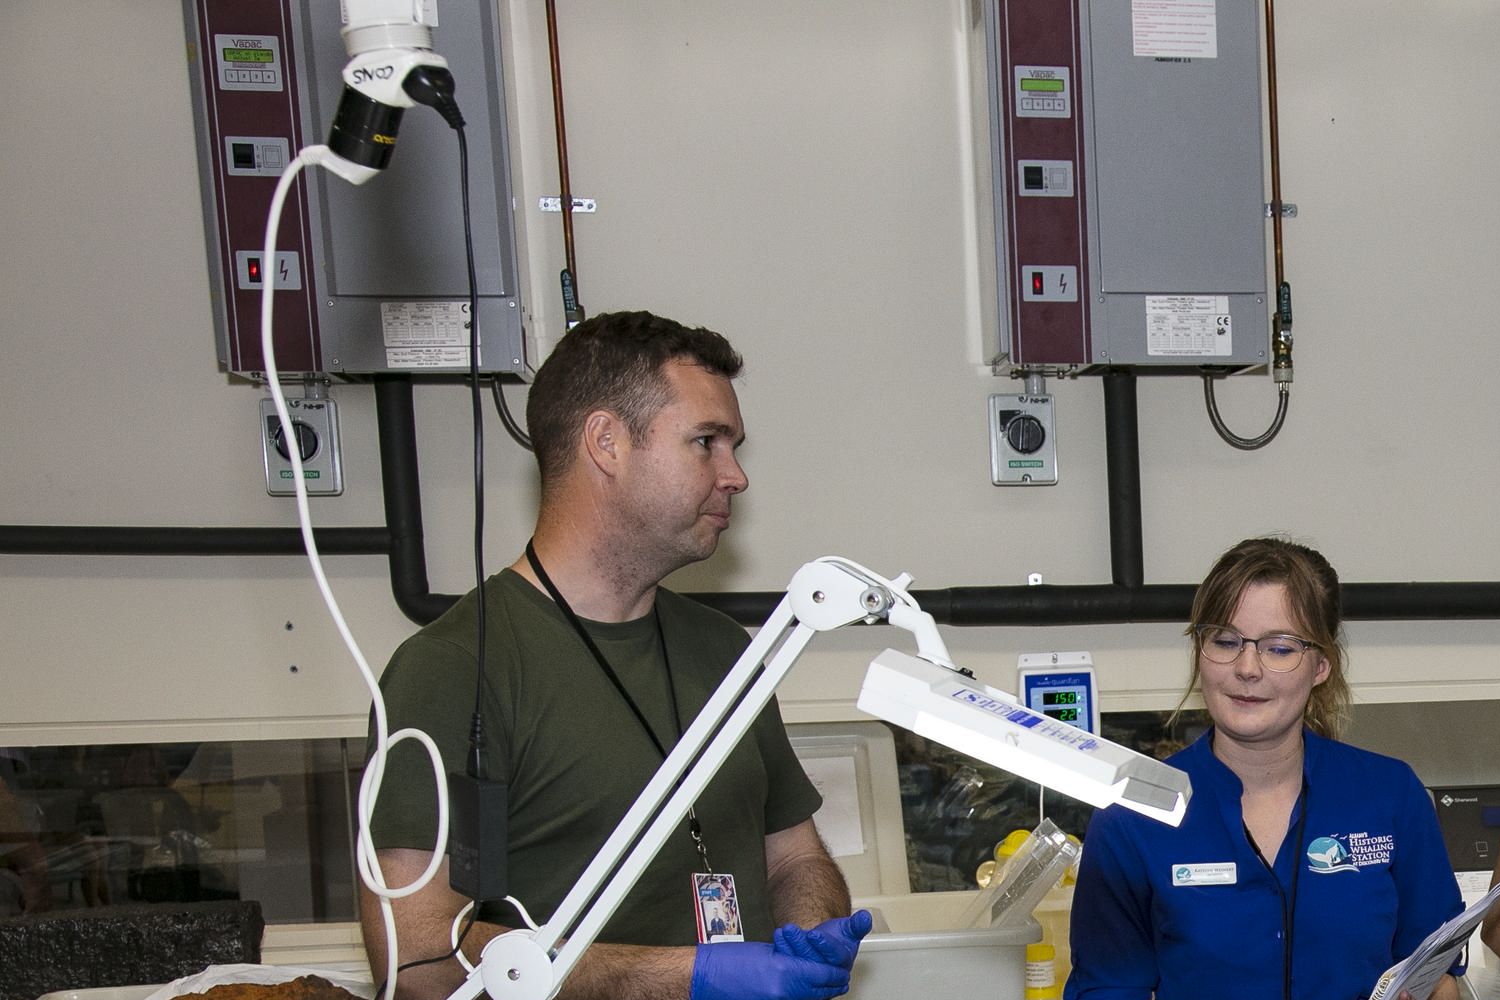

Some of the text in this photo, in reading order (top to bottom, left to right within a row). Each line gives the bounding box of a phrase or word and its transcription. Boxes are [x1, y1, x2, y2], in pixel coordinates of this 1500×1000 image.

[232, 39, 262, 48] Vapac
[1054, 692, 1076, 704] 150
[1060, 708, 1076, 721] 22
[1349, 835, 1393, 847] HISTORIC
[1350, 842, 1394, 854] WHALING
[1352, 850, 1390, 862] STATION
